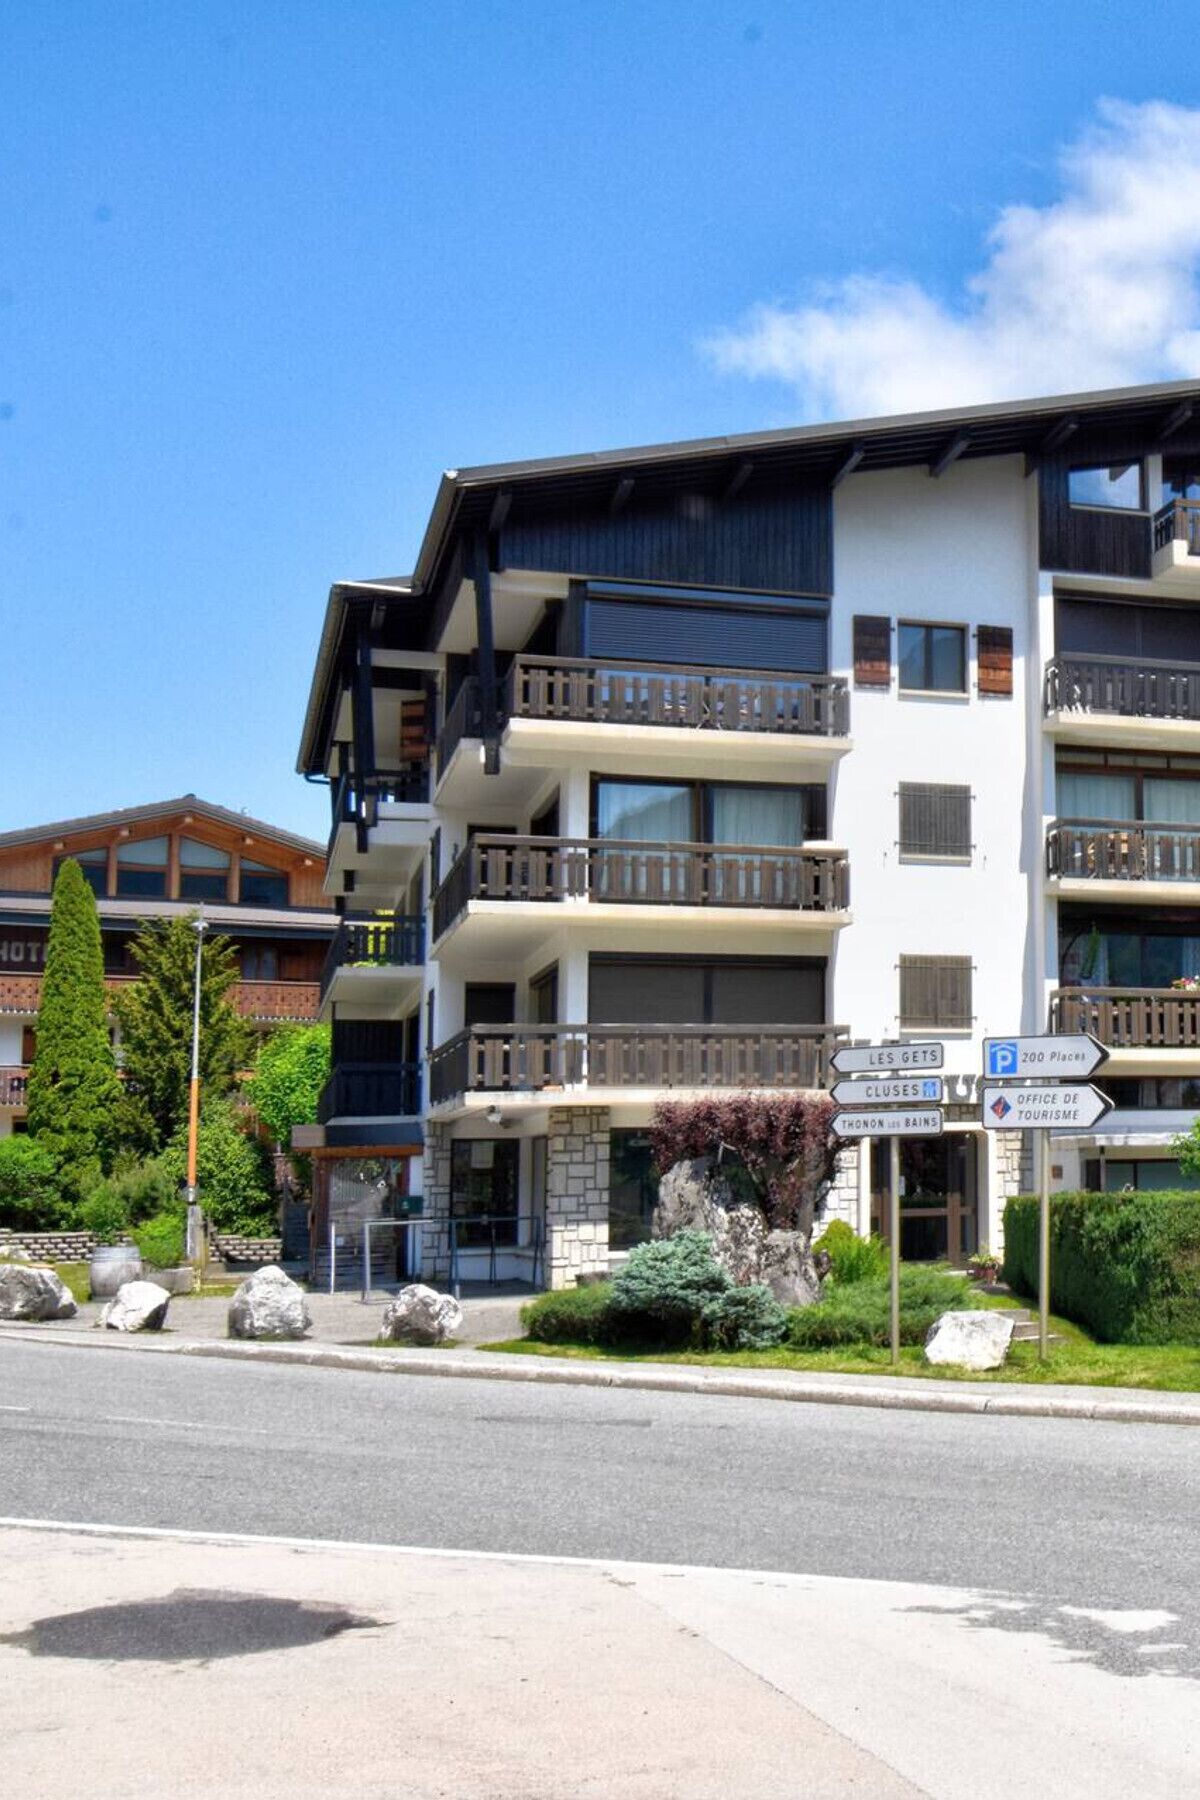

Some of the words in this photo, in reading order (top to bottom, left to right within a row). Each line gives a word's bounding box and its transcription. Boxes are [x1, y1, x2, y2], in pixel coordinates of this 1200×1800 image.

[869, 1052, 894, 1065] LES
[902, 1050, 938, 1063] GETS
[1021, 1051, 1045, 1063] 200
[1049, 1050, 1086, 1062] Places
[865, 1084, 919, 1098] CLUSES
[1016, 1093, 1057, 1104] OFFICE
[1063, 1093, 1080, 1104] DE
[1018, 1110, 1080, 1120] TOURISME
[841, 1119, 885, 1129] THONON
[904, 1117, 938, 1128] BAINS
